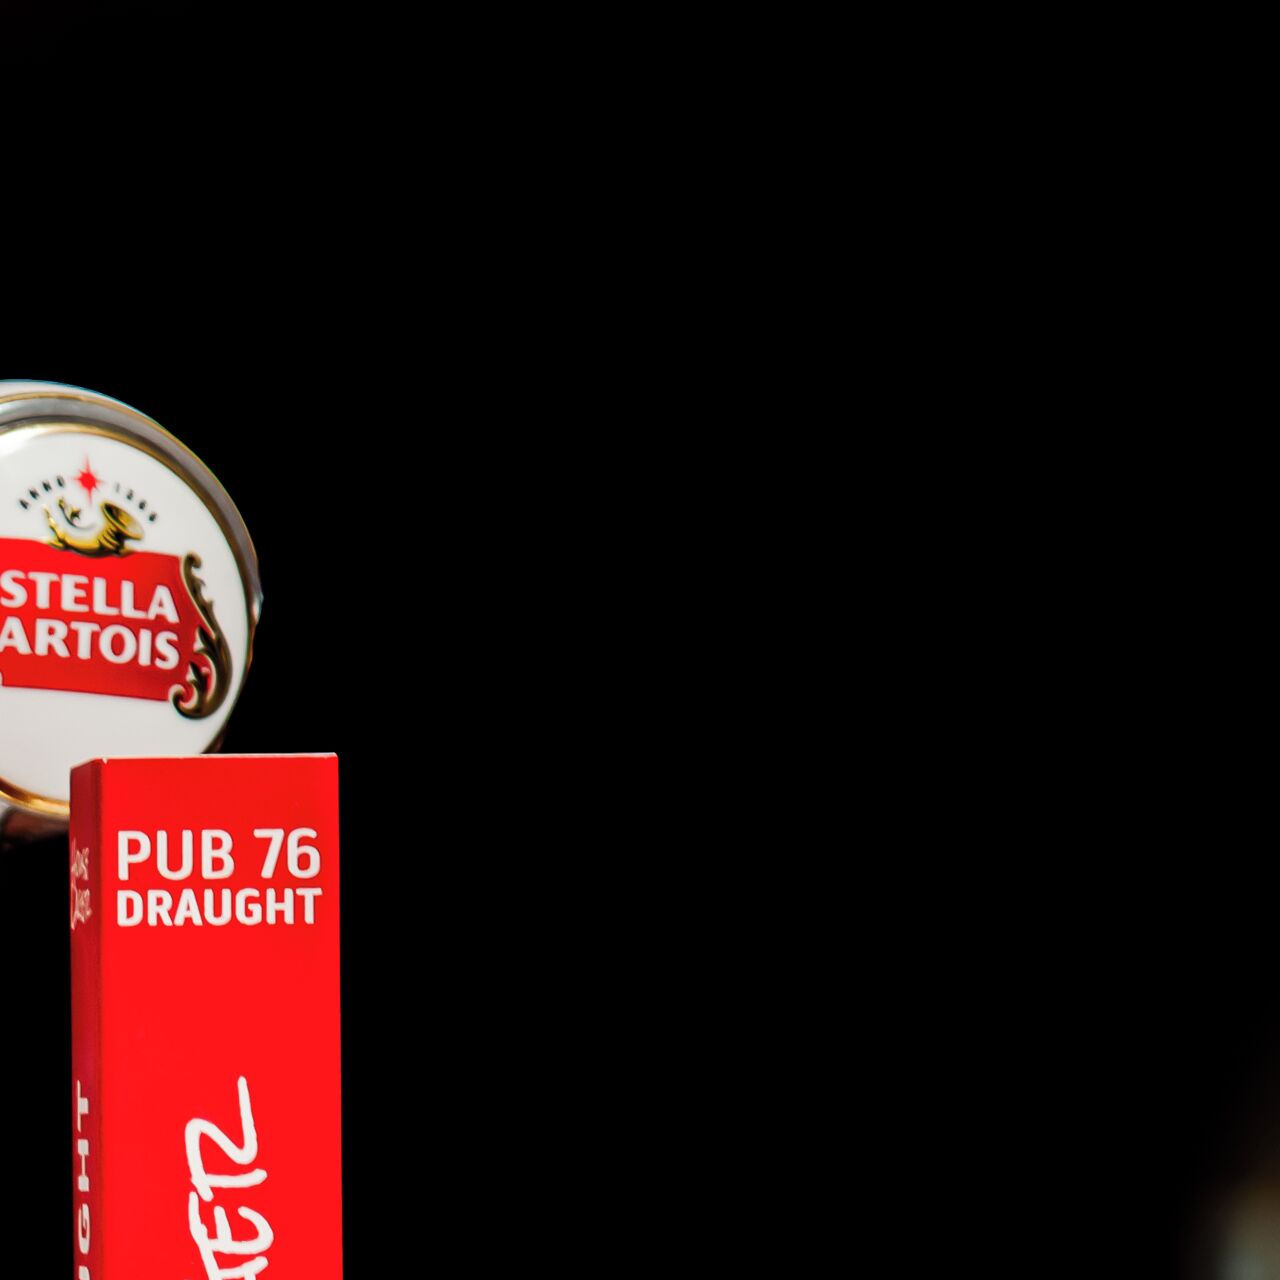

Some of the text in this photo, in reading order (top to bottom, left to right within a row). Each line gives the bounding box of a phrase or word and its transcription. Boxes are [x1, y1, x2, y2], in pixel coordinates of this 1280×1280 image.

[0, 568, 179, 625] STELLA
[116, 827, 322, 881] PUB 76
[115, 886, 323, 928] DRAUGHT
